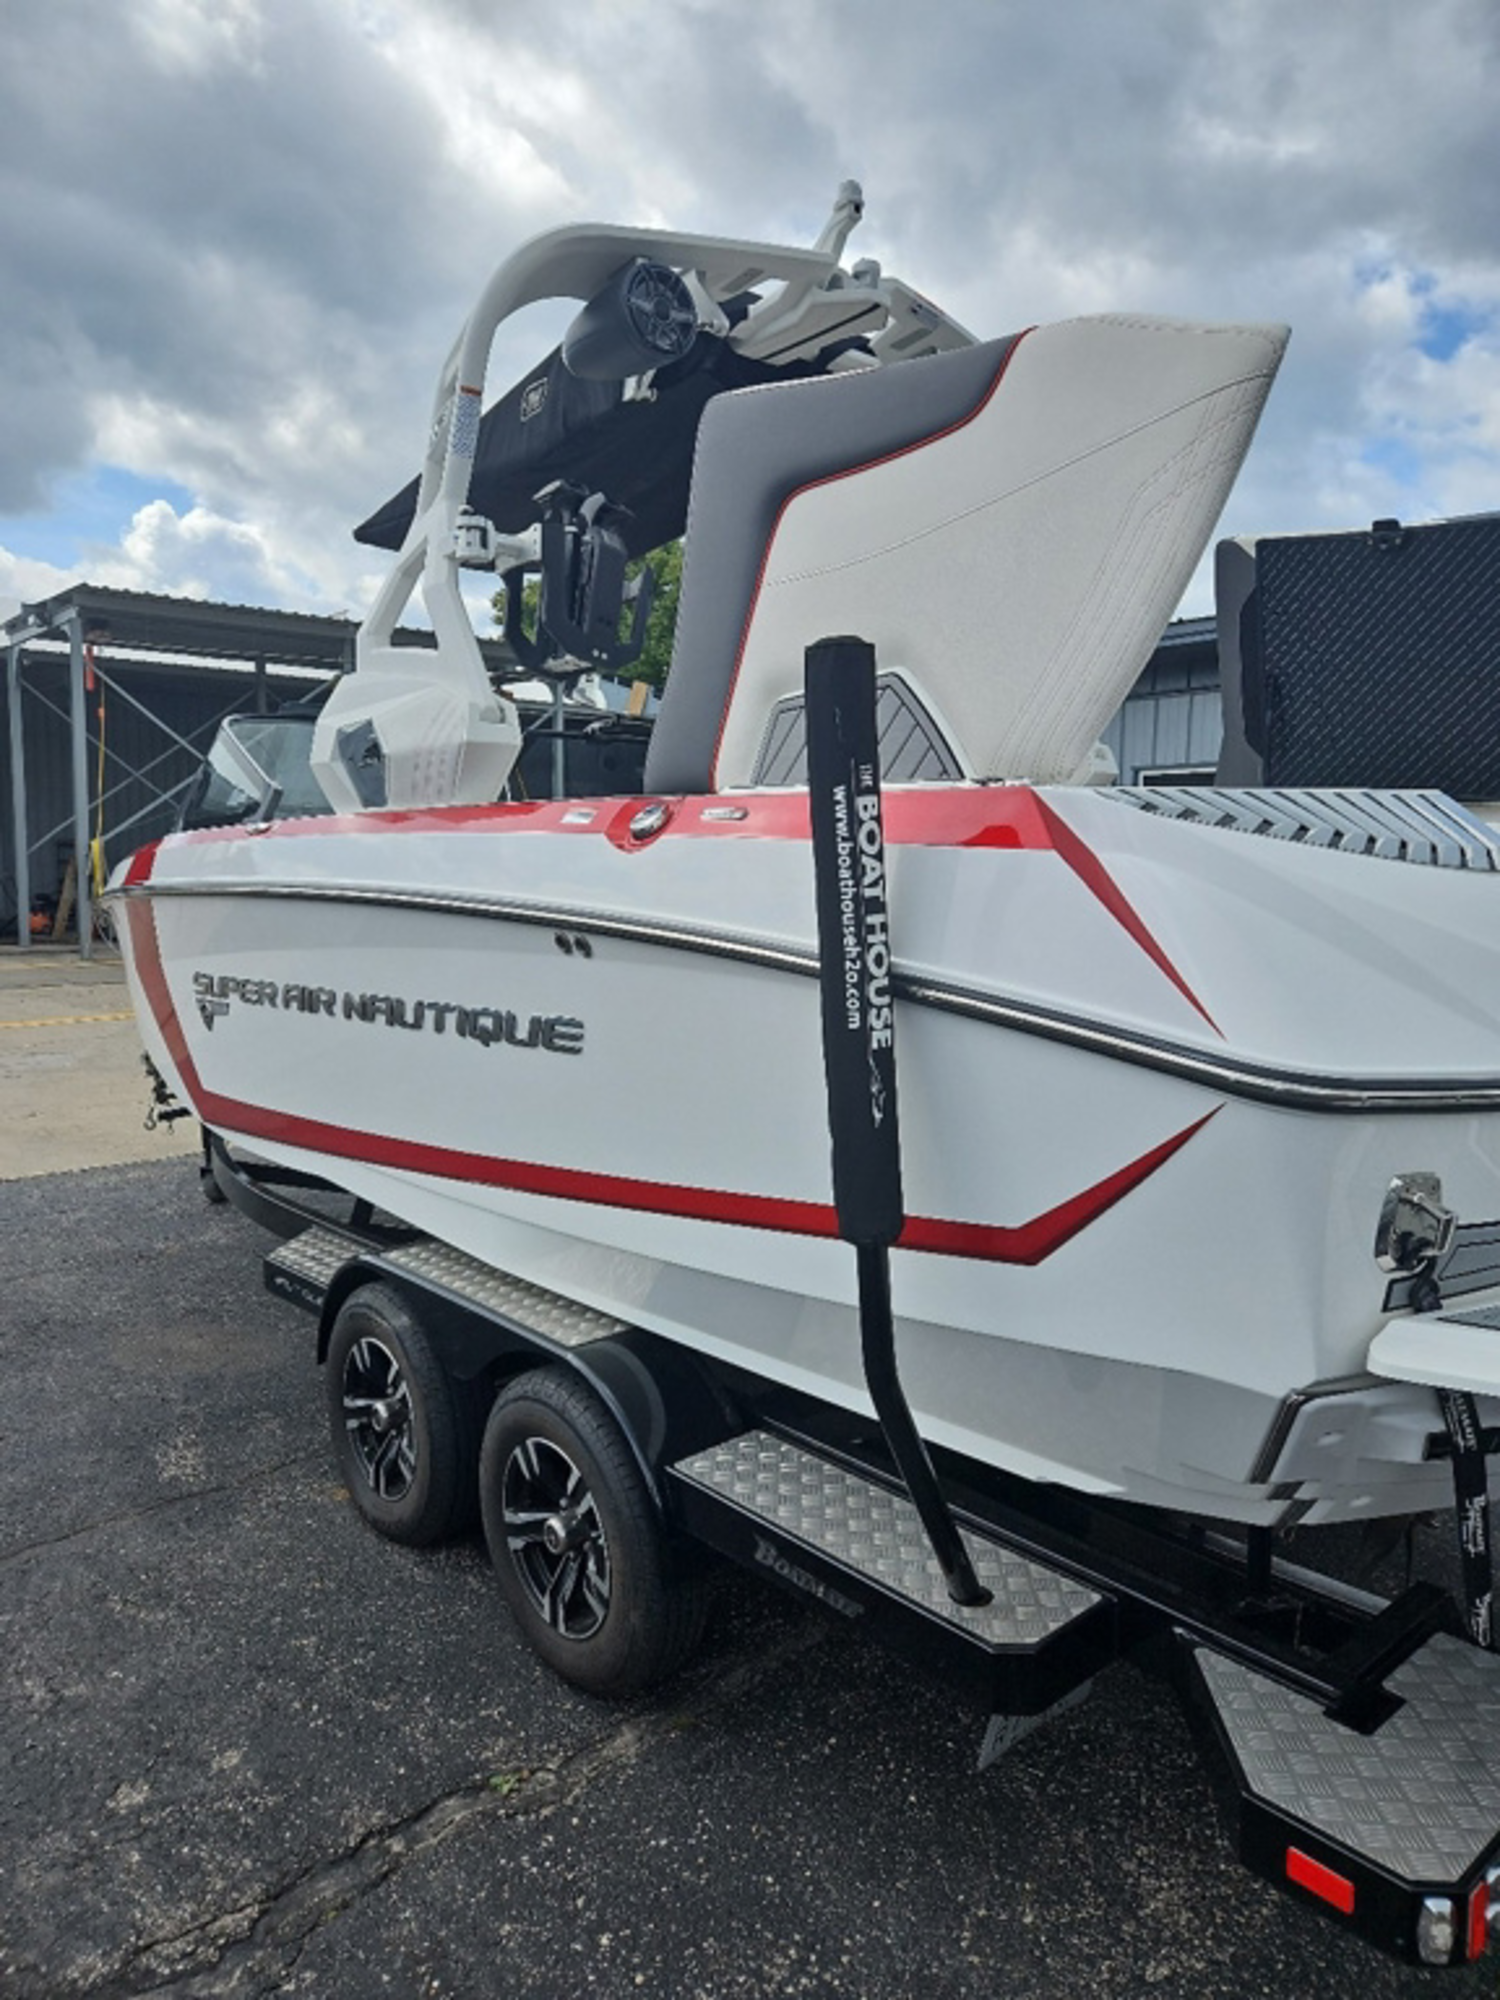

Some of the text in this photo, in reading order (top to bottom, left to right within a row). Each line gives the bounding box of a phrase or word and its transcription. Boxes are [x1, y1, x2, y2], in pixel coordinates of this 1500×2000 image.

[832, 785, 861, 1030] www.boathouseh2o.com
[855, 795, 886, 902] BOAT
[193, 971, 585, 1056] SUPER AIR NAUTIQUE
[864, 913, 892, 1049] HOUSE
